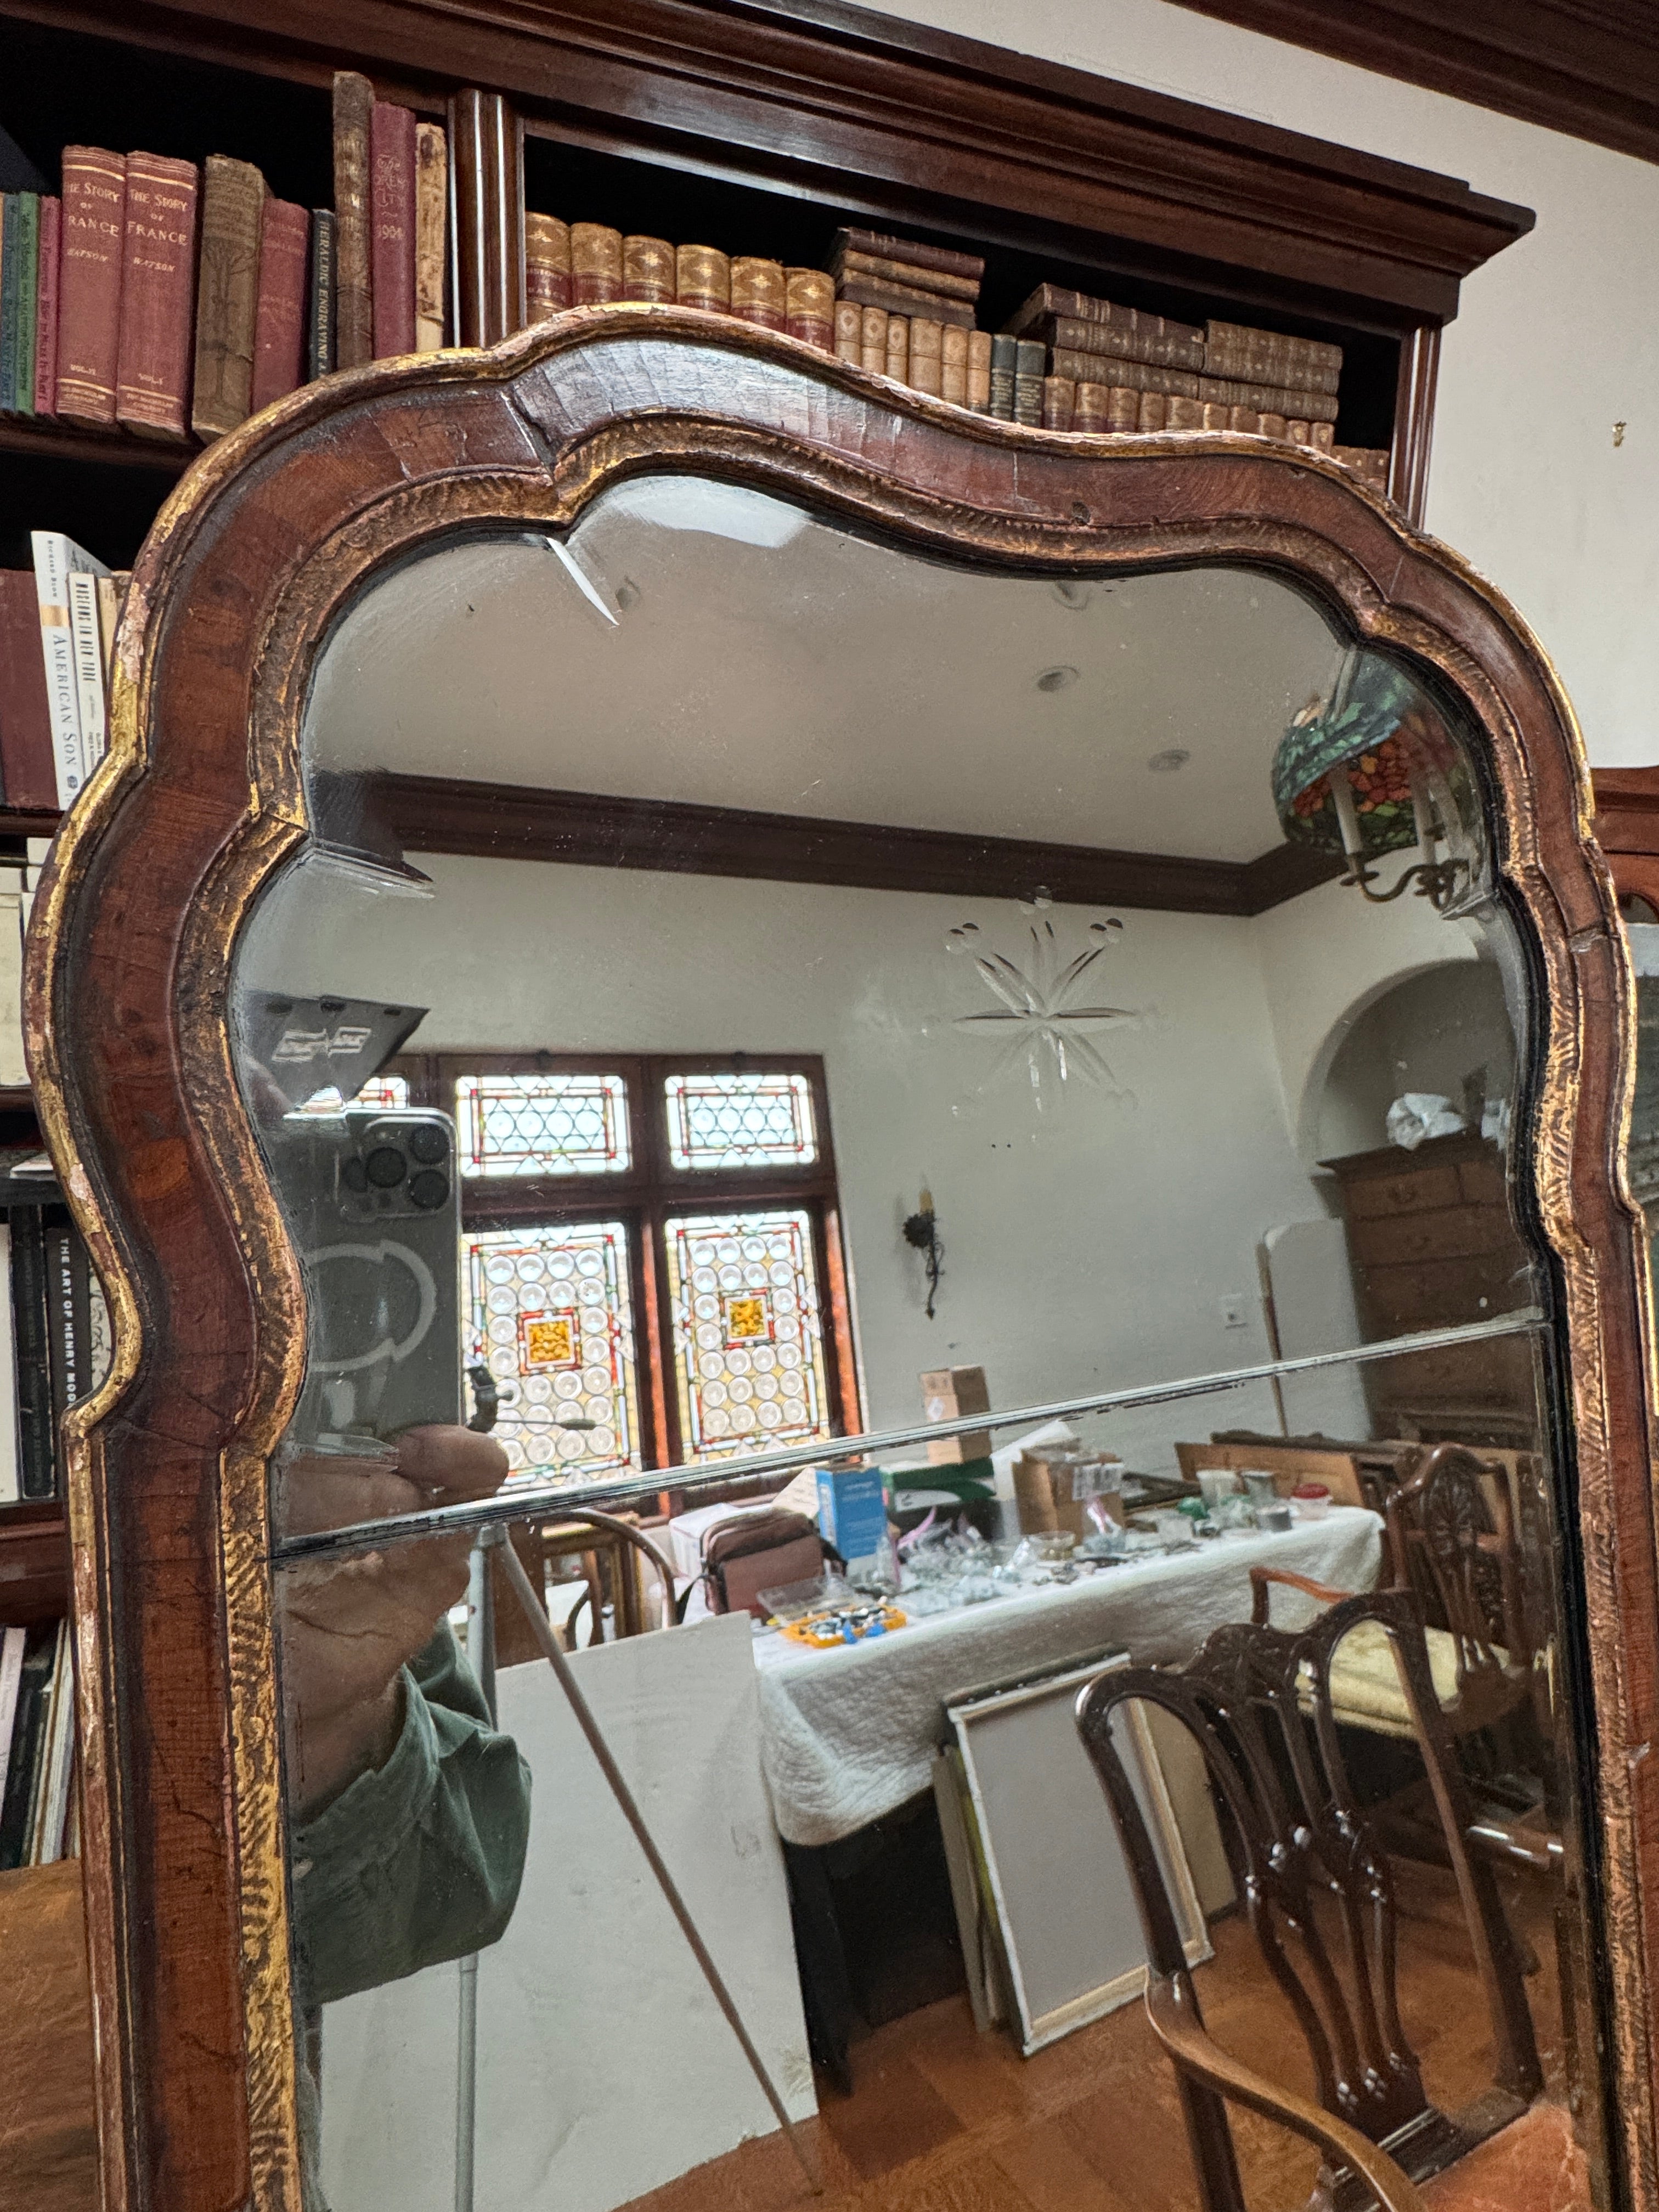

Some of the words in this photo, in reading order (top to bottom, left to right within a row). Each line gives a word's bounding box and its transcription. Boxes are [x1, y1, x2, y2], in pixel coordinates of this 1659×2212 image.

[84, 182, 121, 203] STORY
[129, 189, 150, 204] THE
[154, 194, 188, 212] STORY
[68, 216, 120, 237] RANCE
[127, 221, 188, 246] FRANCE
[133, 256, 176, 272] WATSON
[317, 288, 329, 360] ENGRAVING
[53, 634, 73, 724] AMERICAN
[62, 732, 77, 766] SON
[60, 1238, 70, 1263] THE
[61, 1268, 72, 1296] ART
[63, 1300, 73, 1318] OF
[64, 1322, 75, 1367] HENRY
[66, 1373, 77, 1403] MOO
